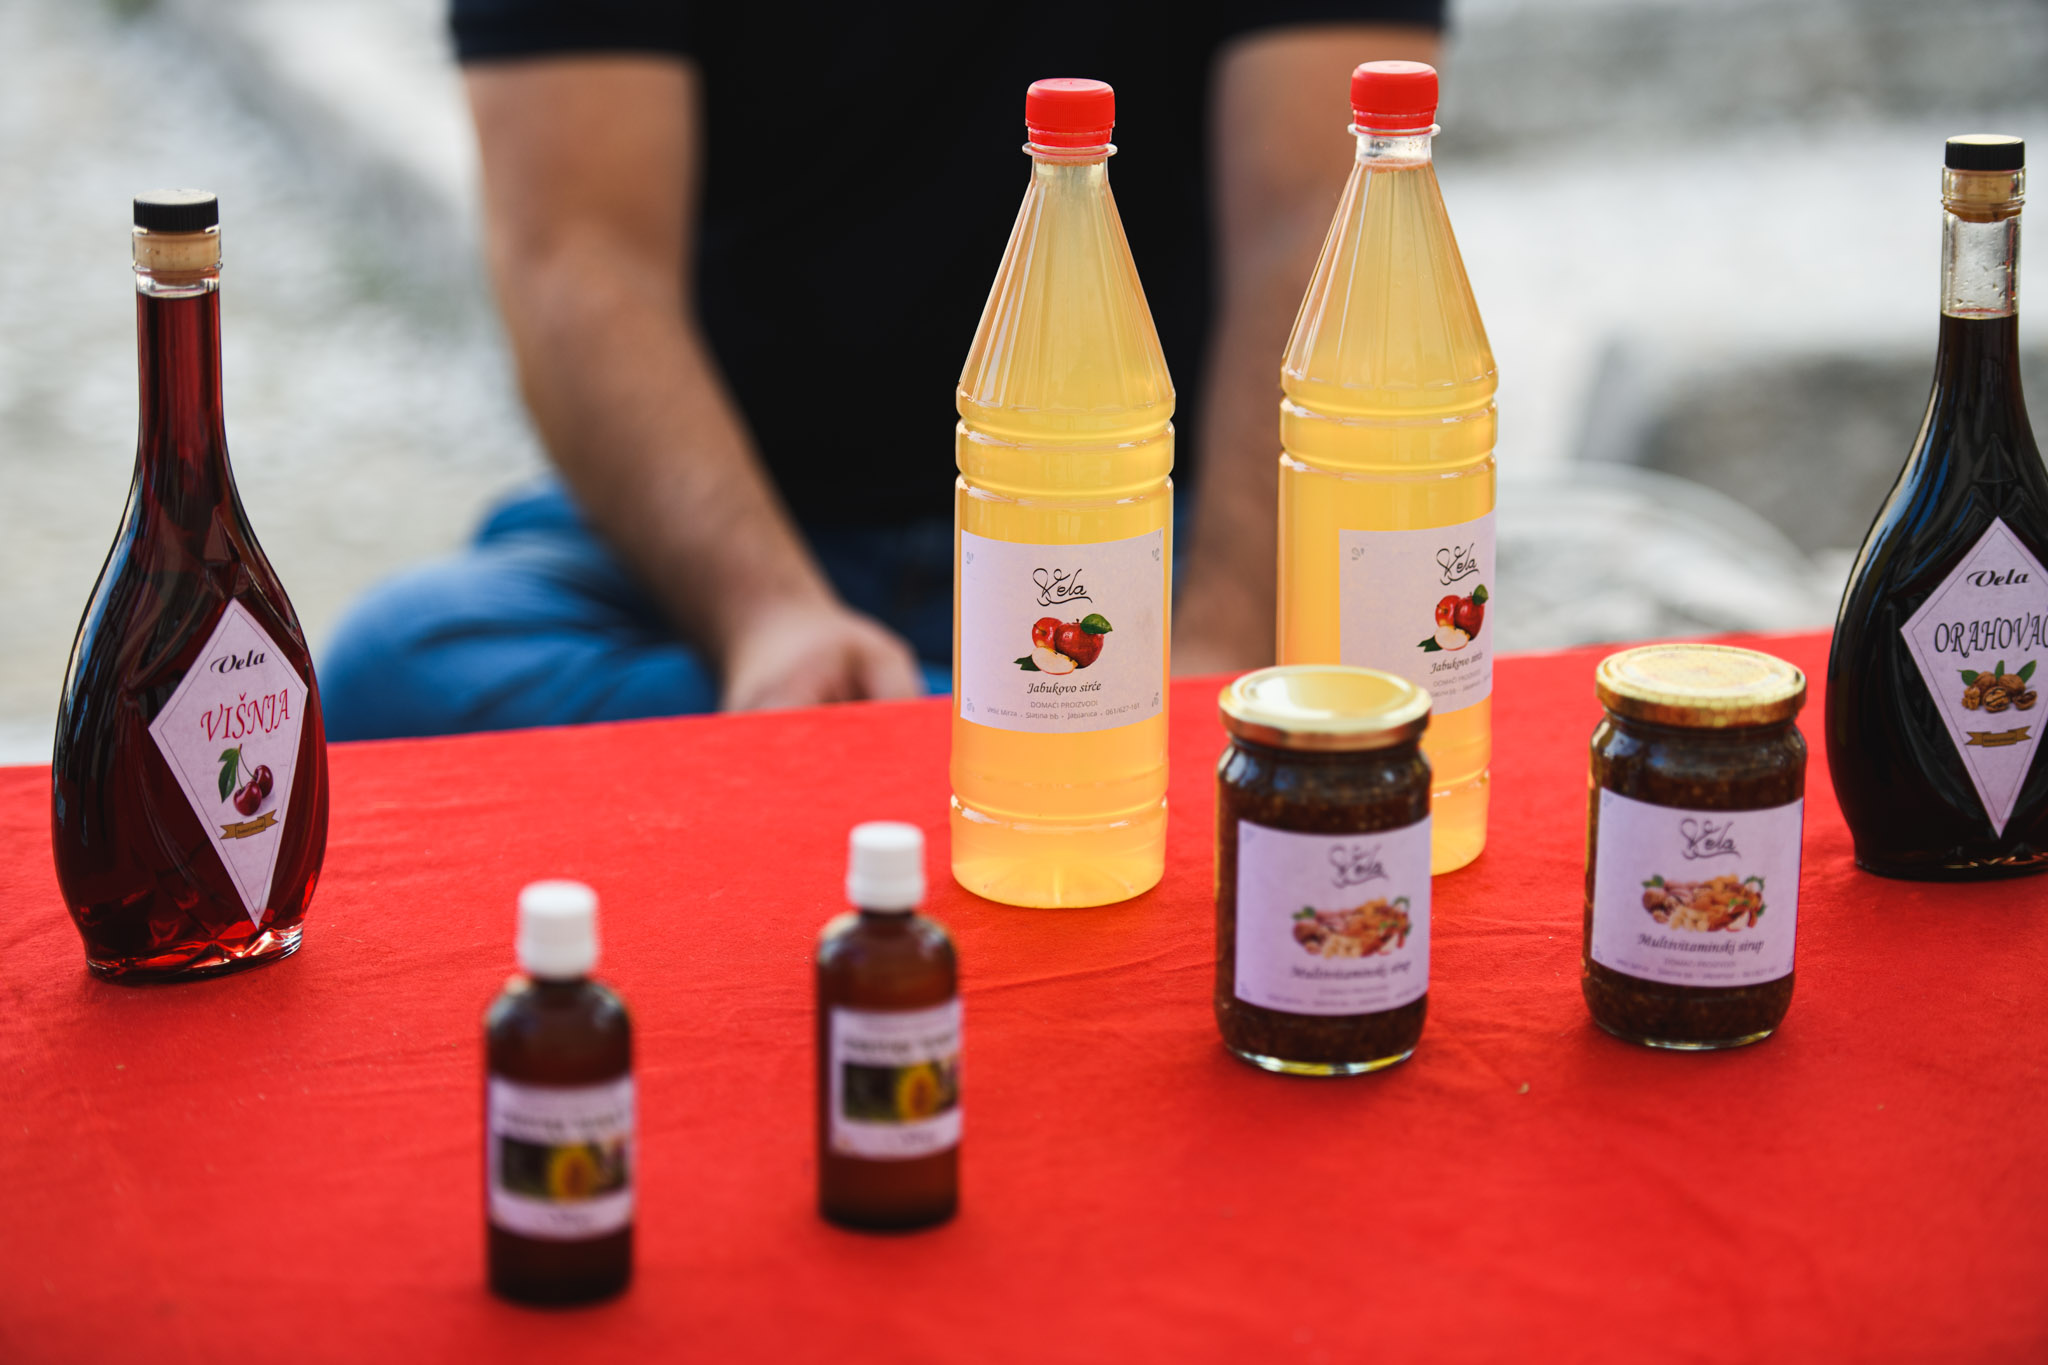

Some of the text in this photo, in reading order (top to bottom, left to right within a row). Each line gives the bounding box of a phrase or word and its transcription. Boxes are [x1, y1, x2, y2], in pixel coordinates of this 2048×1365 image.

[1436, 542, 1480, 586] Vela
[1966, 569, 2029, 587] Vela
[1032, 568, 1093, 607] Vela
[210, 650, 266, 674] Vela
[1027, 681, 1102, 695] Jabukovo sirće
[200, 687, 291, 742] VIŠNJA
[1060, 700, 1098, 709] PROIZVODI
[1680, 818, 1742, 860] Vela
